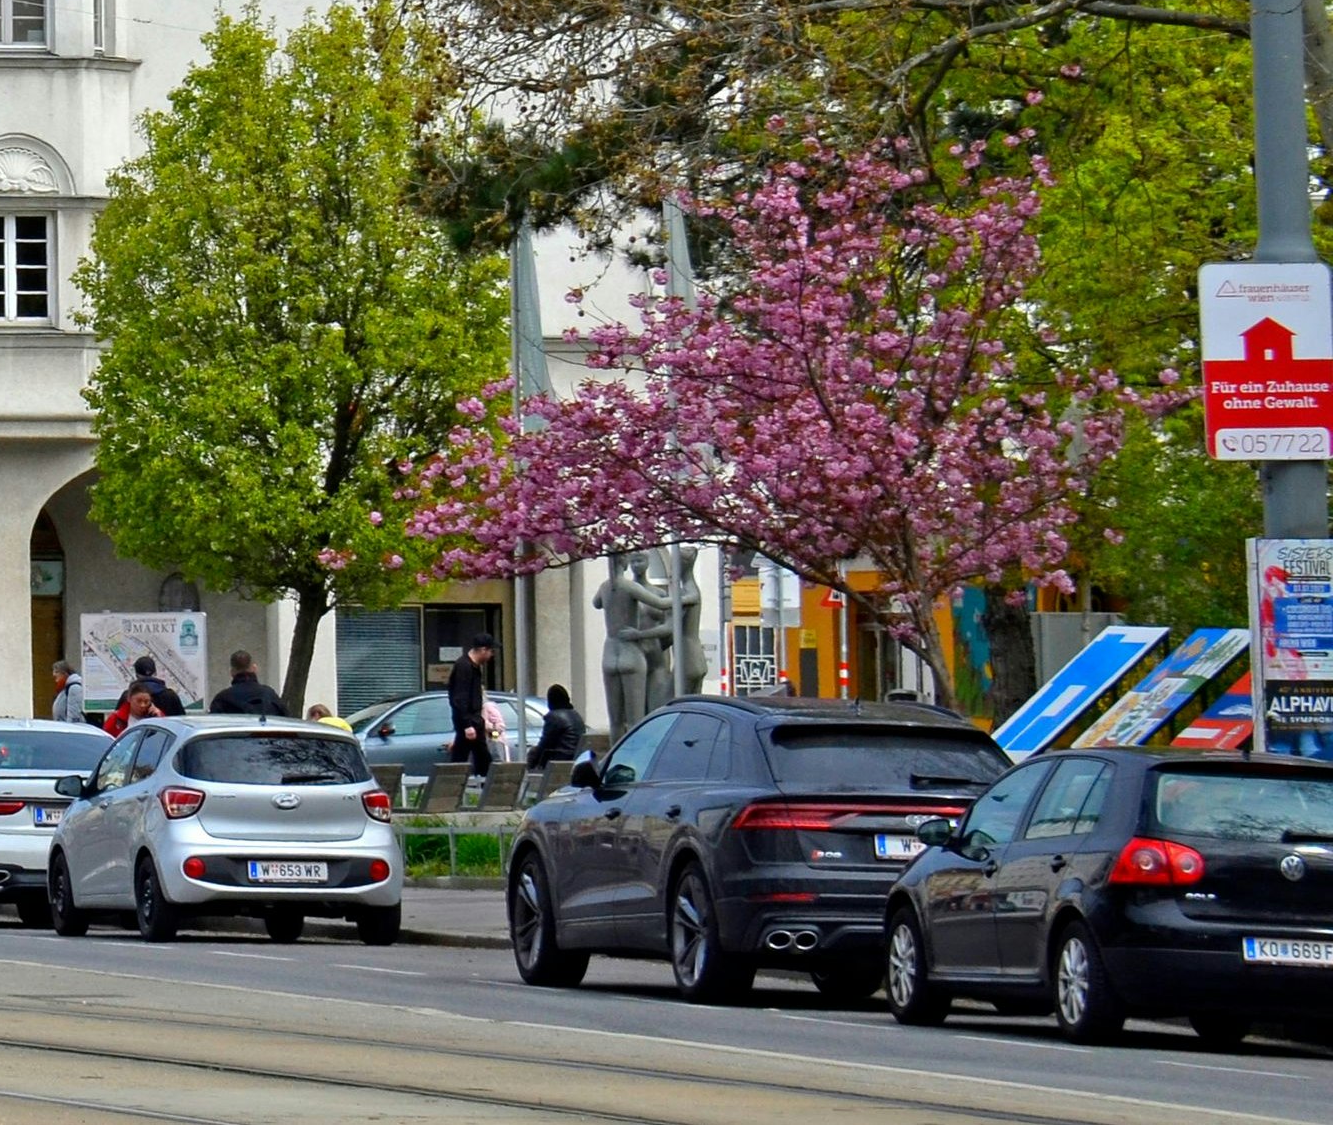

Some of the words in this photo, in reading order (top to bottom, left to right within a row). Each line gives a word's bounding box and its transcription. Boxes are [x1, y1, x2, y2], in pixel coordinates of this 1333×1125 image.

[1239, 284, 1310, 294] frauenhäuser
[1247, 294, 1275, 303] wien
[1211, 380, 1236, 394] Für
[1239, 381, 1264, 394] ein
[1266, 380, 1330, 393] Zuhause
[1223, 397, 1262, 410] ohne
[1264, 396, 1319, 409] Gewalt.
[1277, 546, 1333, 560] SISTERS
[1283, 560, 1331, 575] FESTIVAL
[133, 623, 177, 633] MARKT
[45, 810, 54, 822] W
[901, 838, 912, 852] W
[261, 863, 272, 877] W
[279, 864, 302, 877] 653
[304, 864, 321, 877] WR
[1258, 941, 1279, 957] KO
[1291, 942, 1321, 960] 669
